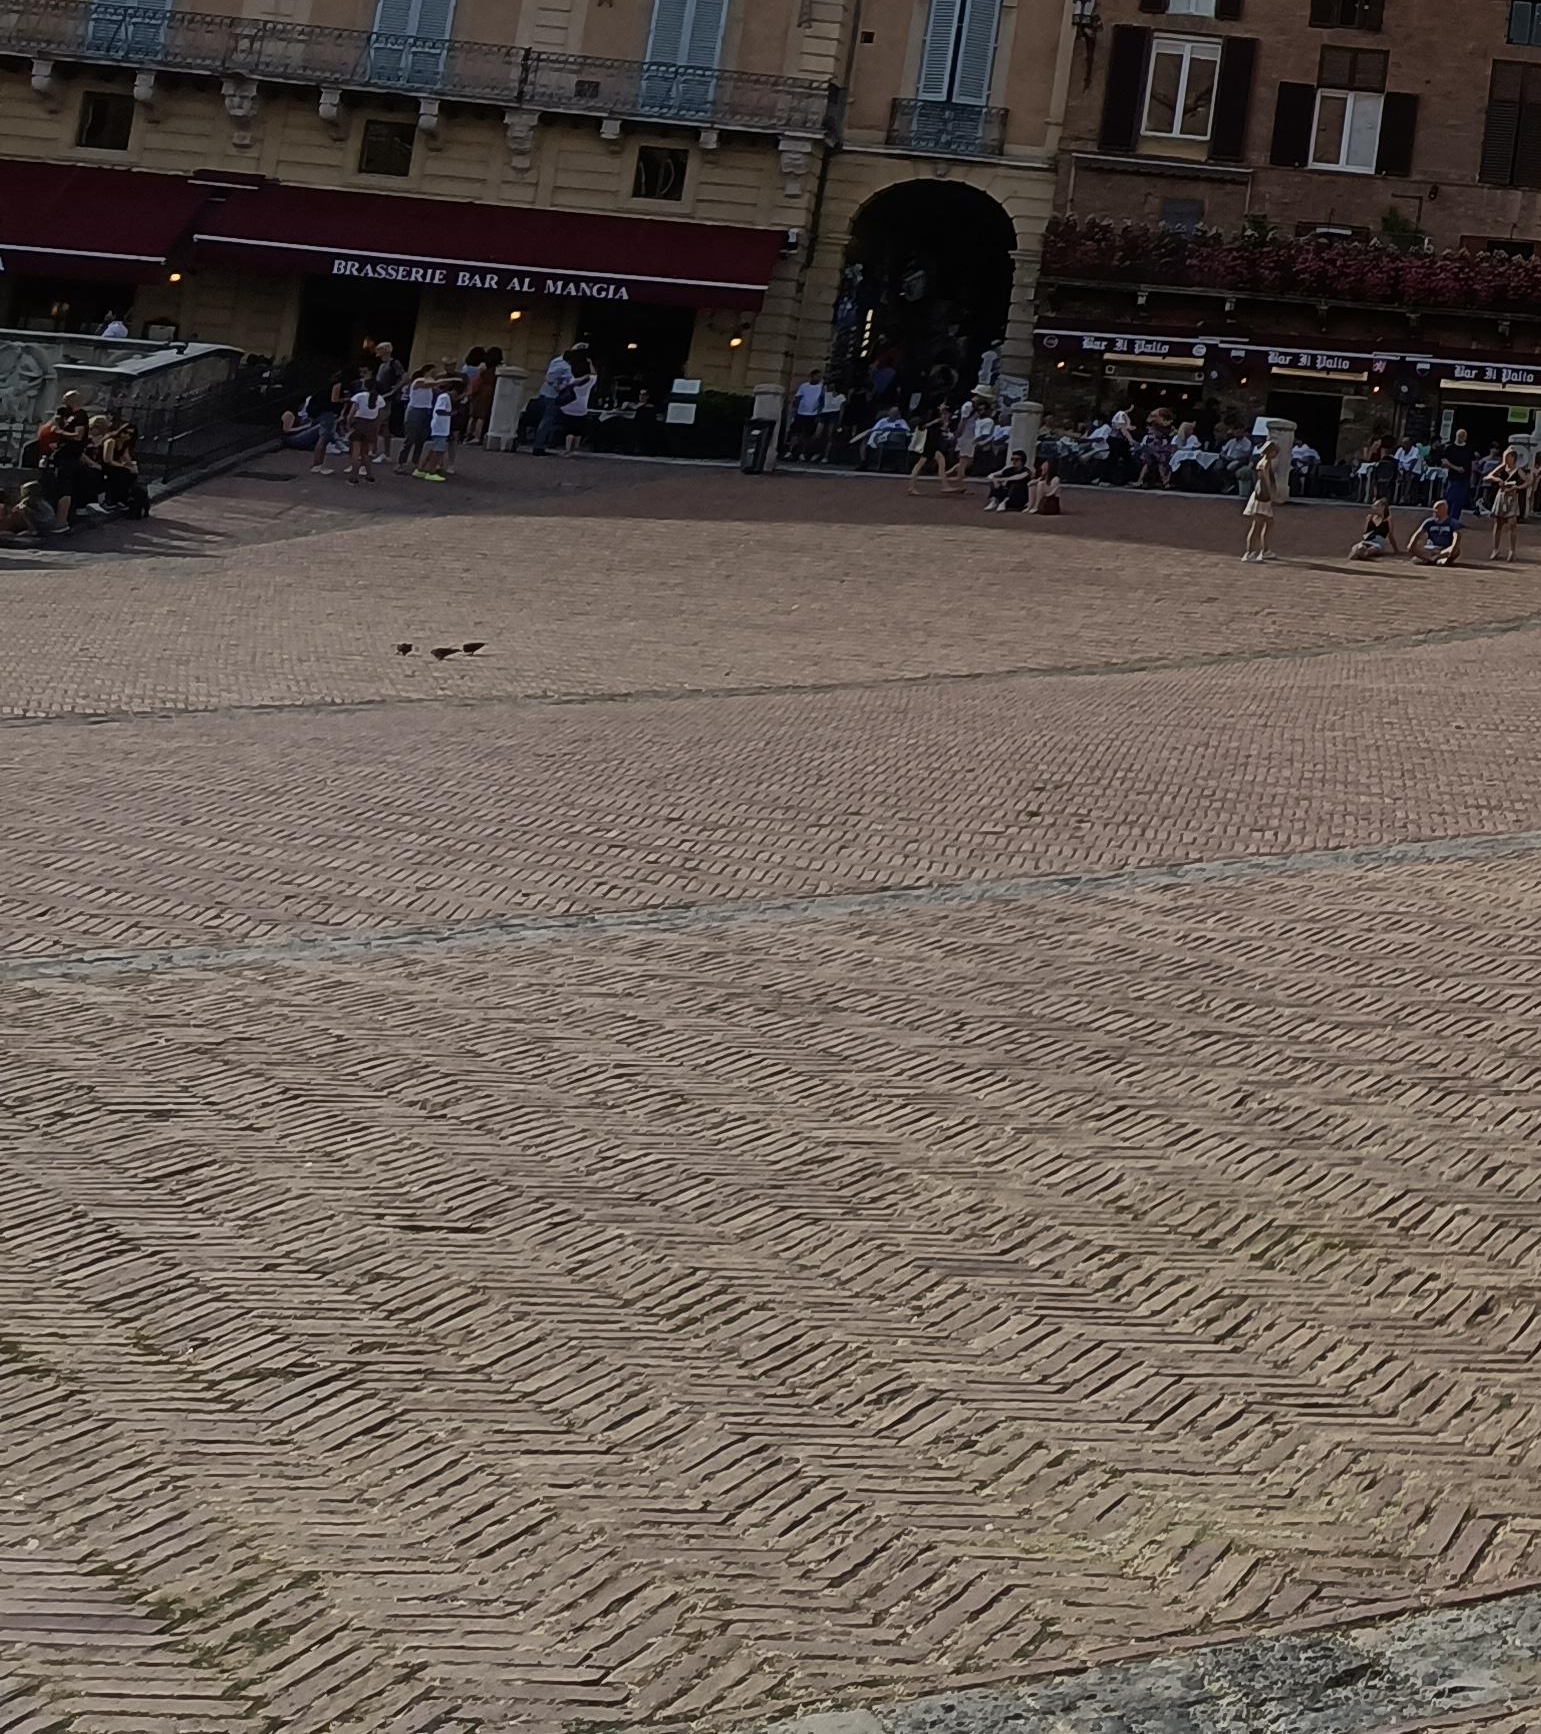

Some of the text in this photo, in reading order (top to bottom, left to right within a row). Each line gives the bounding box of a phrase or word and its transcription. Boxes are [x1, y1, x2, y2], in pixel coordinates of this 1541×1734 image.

[331, 259, 630, 300] BRASSERIE BAR AL MANGIA
[1081, 336, 1108, 351] Bar
[1134, 340, 1170, 355] Palio
[1267, 350, 1293, 365] Bar
[1315, 354, 1350, 370] Palio
[1454, 365, 1478, 379] Bar
[1501, 368, 1535, 384] Palio
